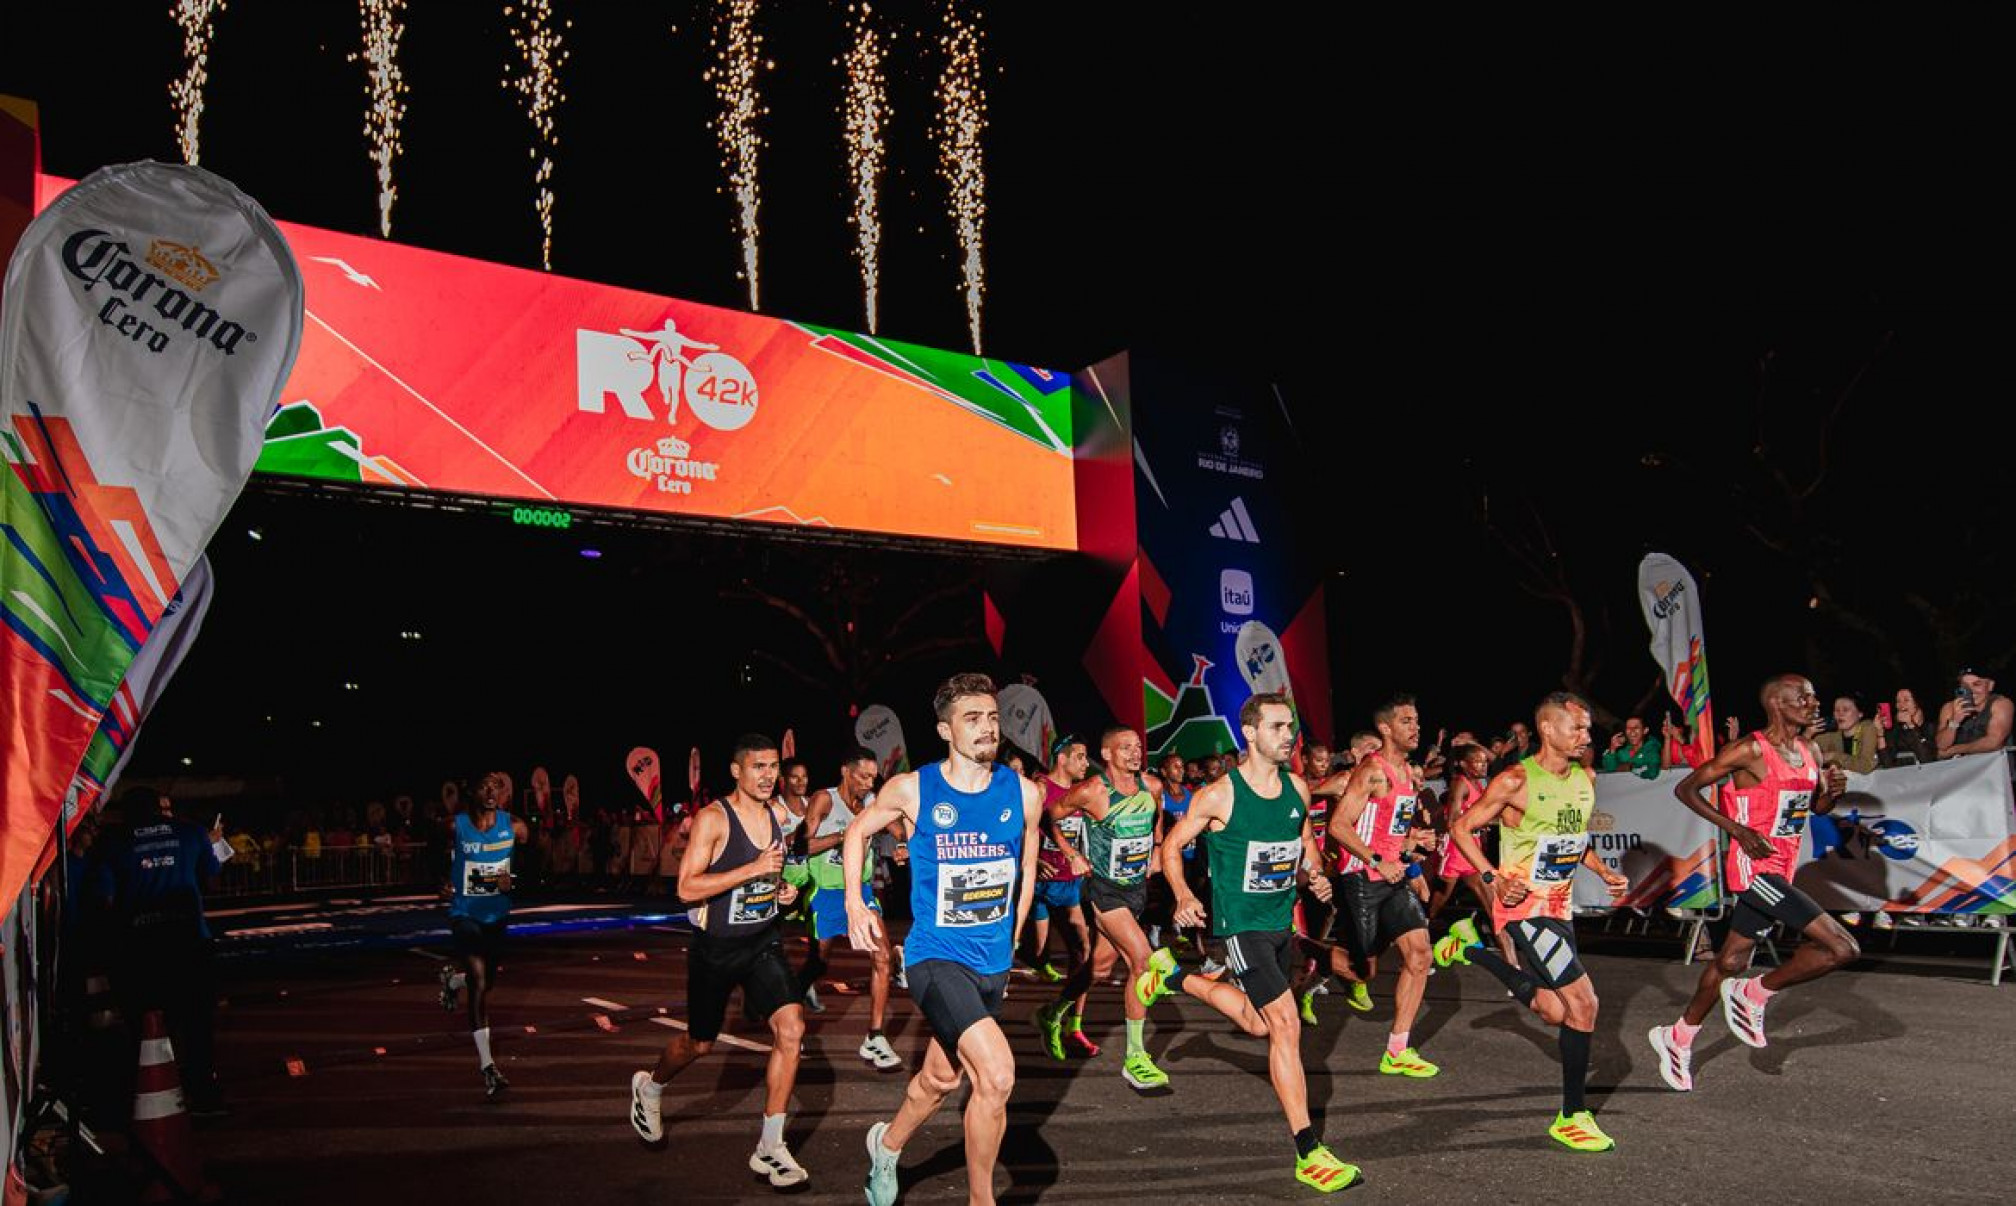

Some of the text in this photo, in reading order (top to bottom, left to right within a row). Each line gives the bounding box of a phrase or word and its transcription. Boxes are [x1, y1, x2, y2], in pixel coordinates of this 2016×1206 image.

[98, 297, 170, 353] Cero
[697, 375, 757, 407] 42k
[626, 448, 720, 481] Corona
[1215, 461, 1227, 473] DE
[1228, 464, 1264, 480] JANEIRO
[657, 476, 692, 494] Cero
[513, 507, 571, 528] 000002
[935, 832, 979, 847] ELITE
